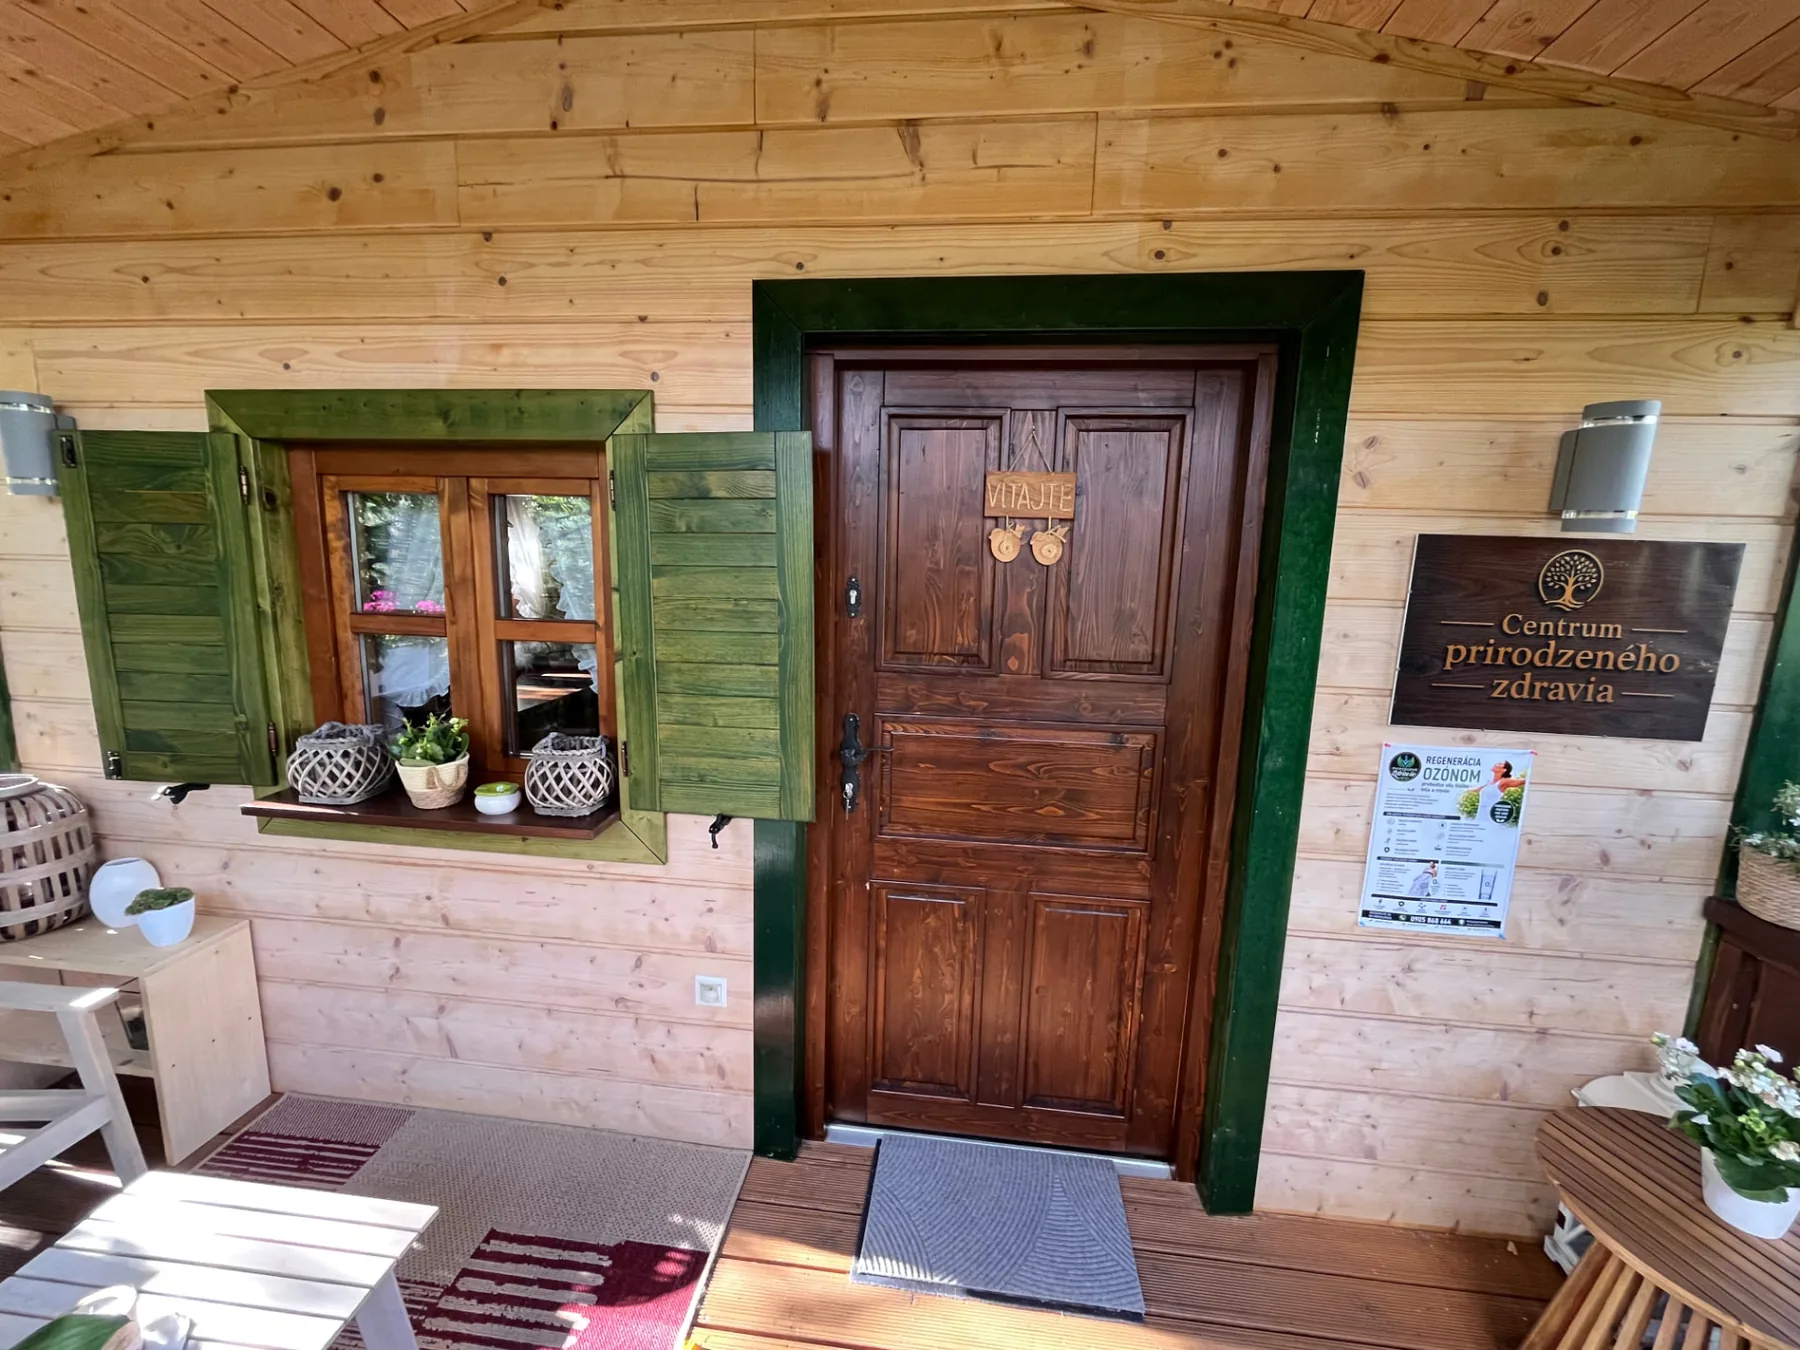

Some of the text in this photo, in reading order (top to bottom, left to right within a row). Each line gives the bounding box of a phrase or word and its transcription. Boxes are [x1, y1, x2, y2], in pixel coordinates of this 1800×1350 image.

[987, 482, 1073, 512] VITAJTE
[1502, 613, 1623, 639] Centrum
[1443, 638, 1681, 674] prirodzeného
[1490, 672, 1615, 704] zdravia
[1423, 766, 1481, 783] OZÓNOM
[1425, 755, 1481, 767] REGENERÁCIA
